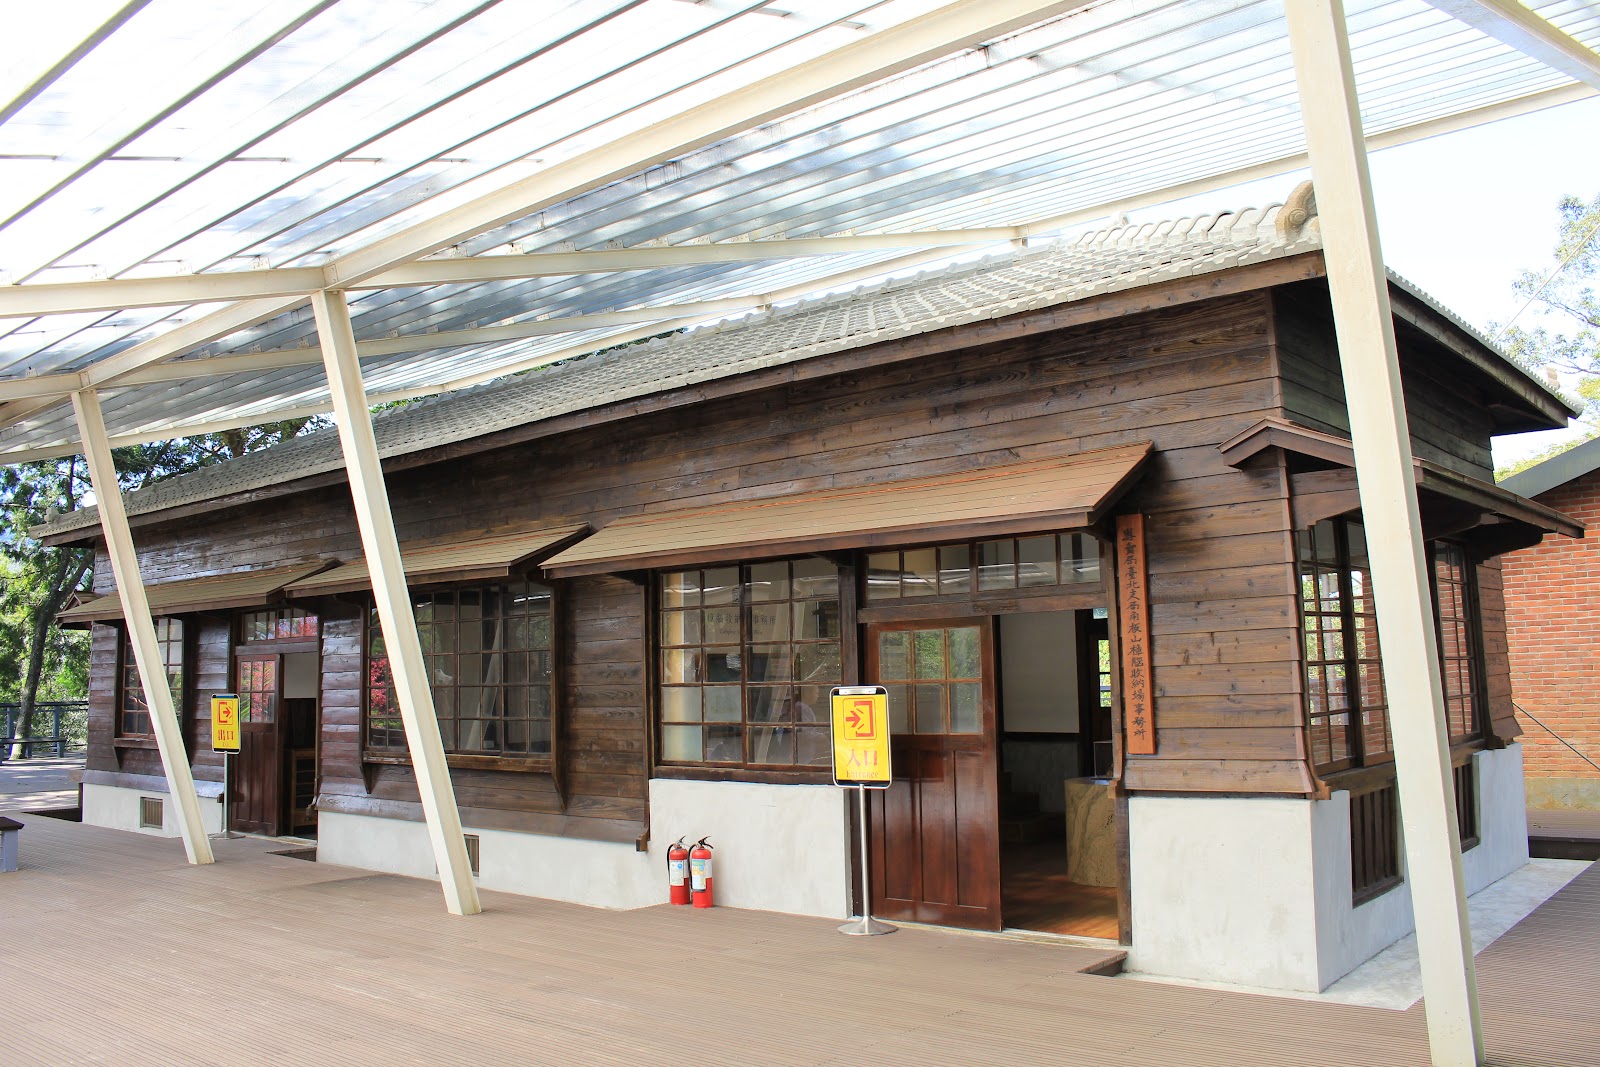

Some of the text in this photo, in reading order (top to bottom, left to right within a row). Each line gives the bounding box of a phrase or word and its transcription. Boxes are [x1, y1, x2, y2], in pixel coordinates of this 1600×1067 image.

[218, 729, 234, 741] 出口
[847, 748, 878, 768] 入口
[846, 770, 879, 779] Entrance
